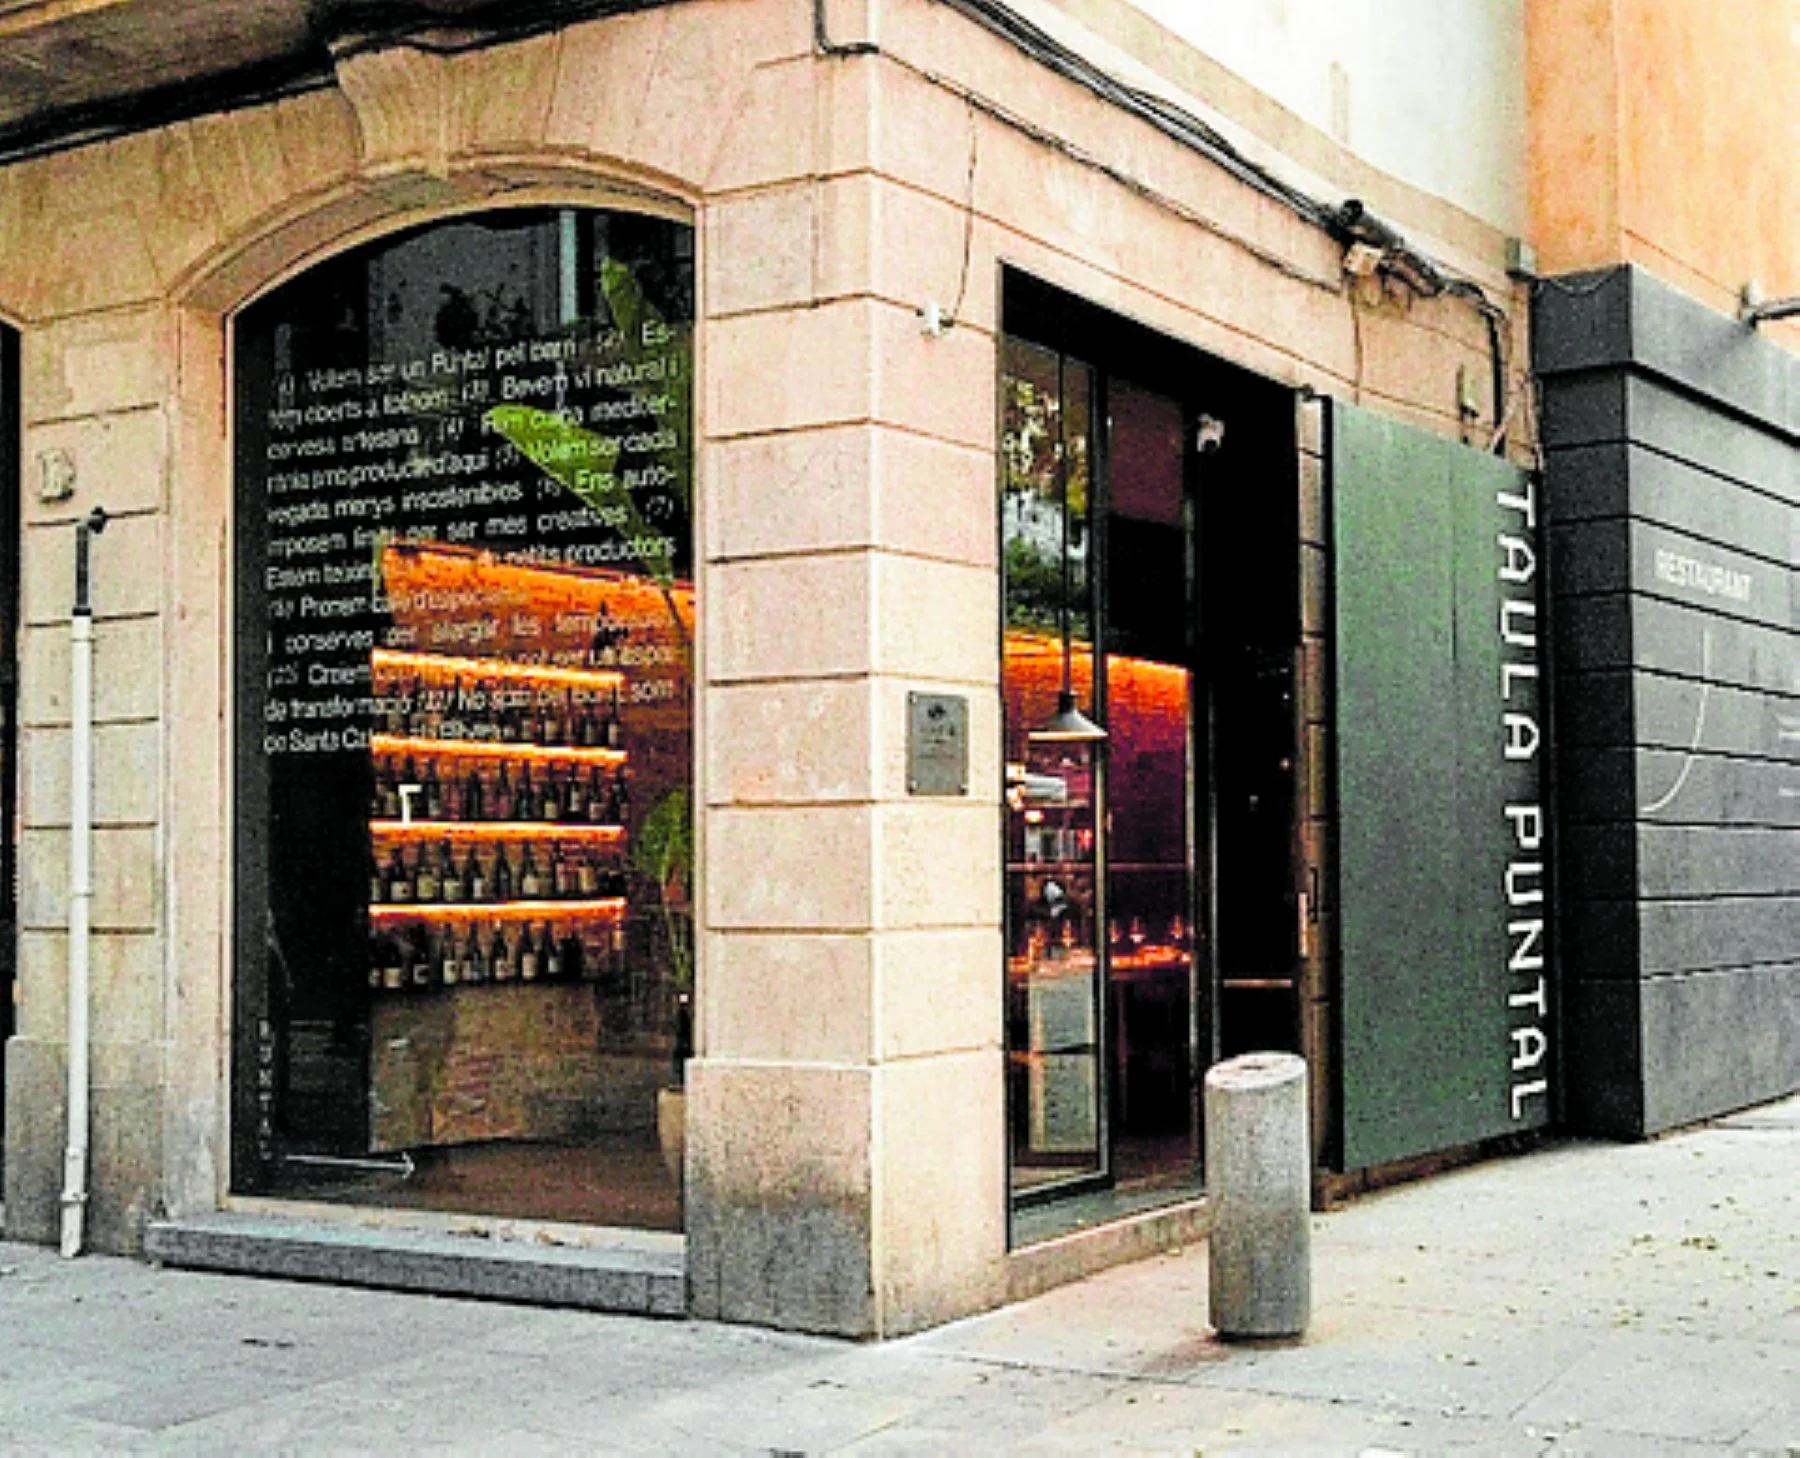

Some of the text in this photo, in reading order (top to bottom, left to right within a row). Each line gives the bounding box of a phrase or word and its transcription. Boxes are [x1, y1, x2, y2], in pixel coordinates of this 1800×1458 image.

[596, 357, 667, 386] natural
[1496, 483, 1547, 1119] TAULA PUNTAL
